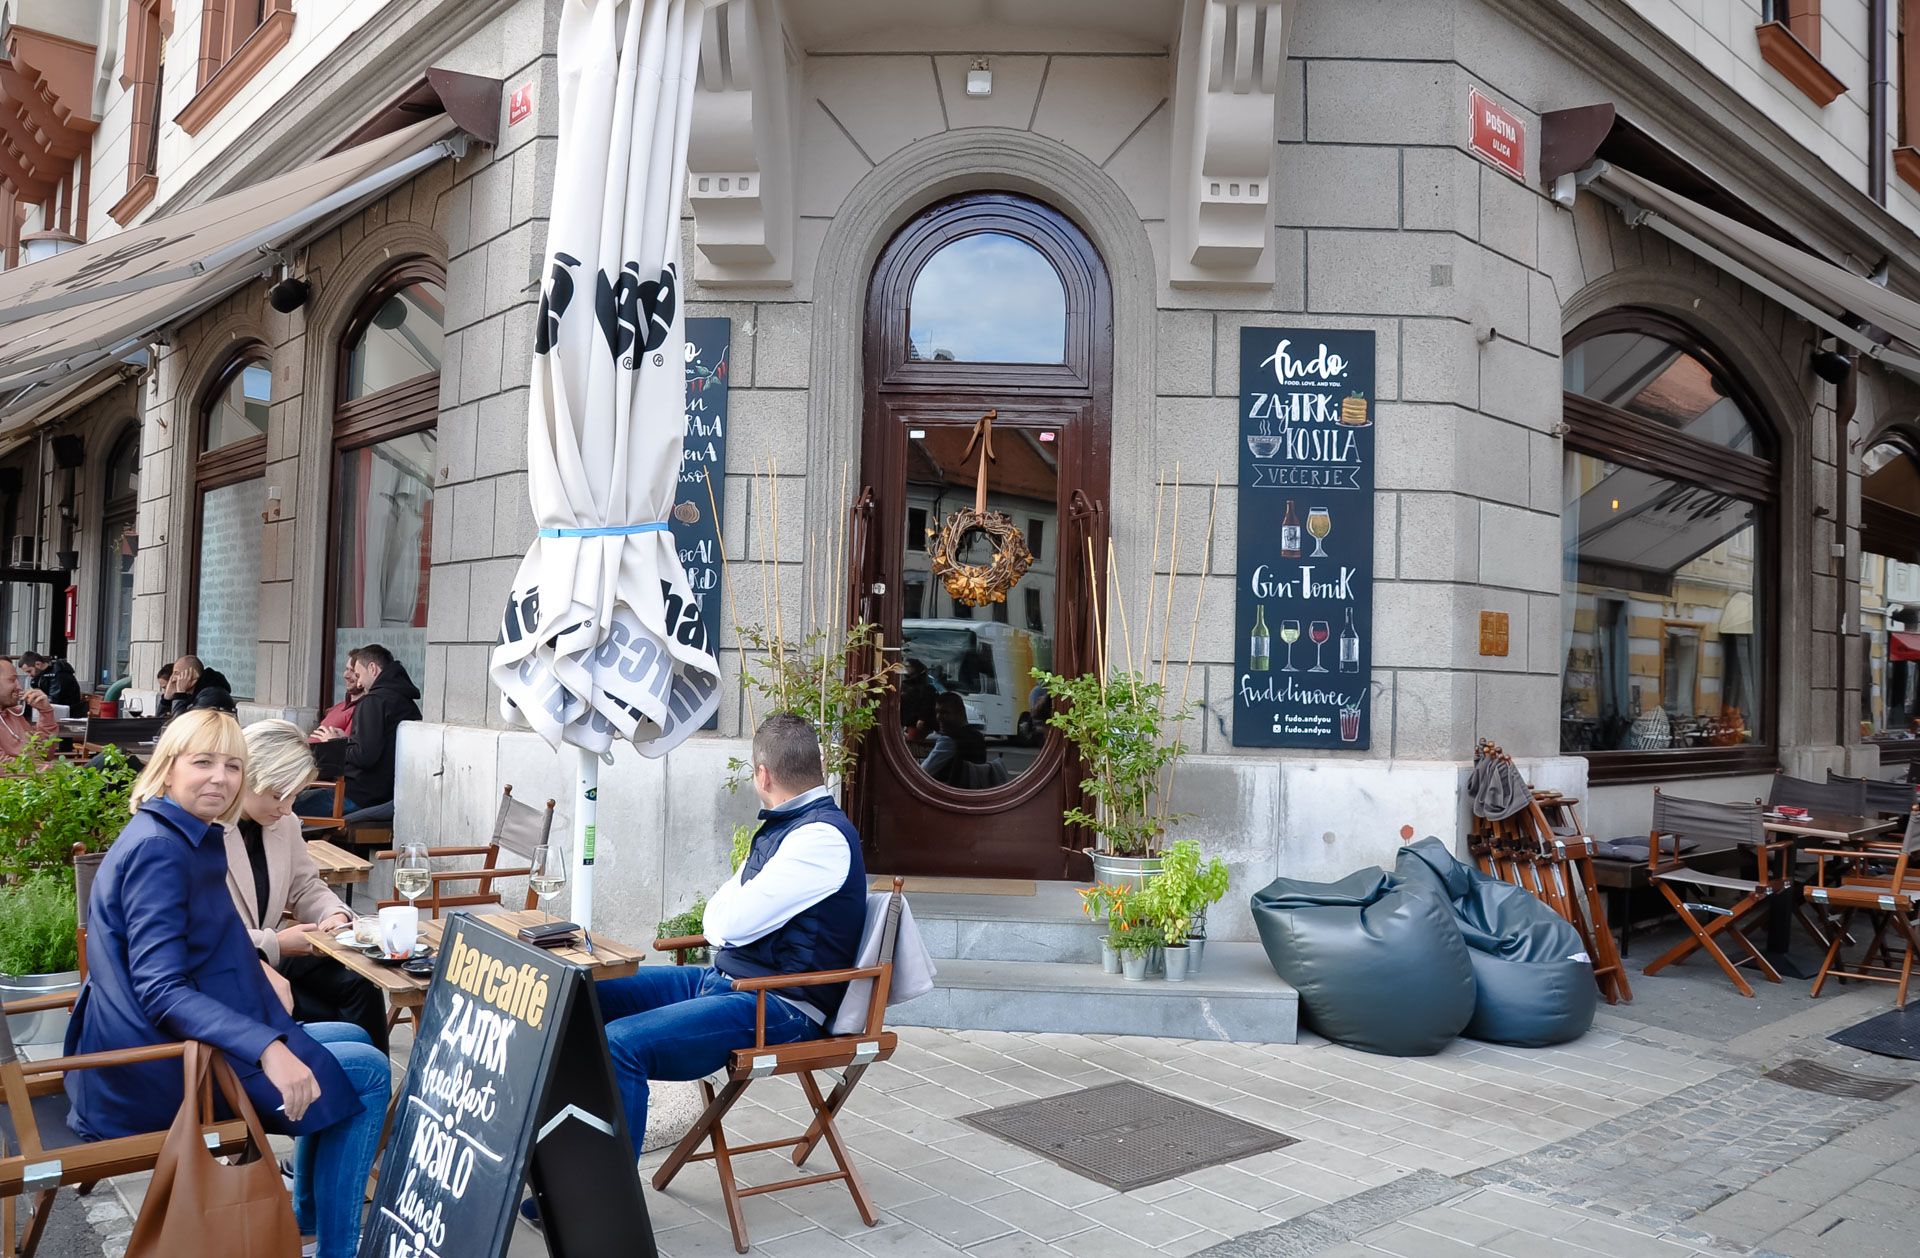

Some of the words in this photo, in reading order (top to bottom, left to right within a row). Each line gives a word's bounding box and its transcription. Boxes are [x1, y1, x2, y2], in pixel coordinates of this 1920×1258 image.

[1492, 138, 1511, 158] ULICA
[1286, 427, 1362, 463] KOSILA
[1268, 467, 1343, 486] VEČERJE
[1284, 714, 1332, 725] fudo.andyou
[1284, 725, 1332, 736] fudo.andyou
[445, 931, 550, 1028] barcaffé
[439, 993, 517, 1075] ZAJTRK
[421, 1043, 496, 1123] breakfast
[395, 1167, 446, 1248] lunch
